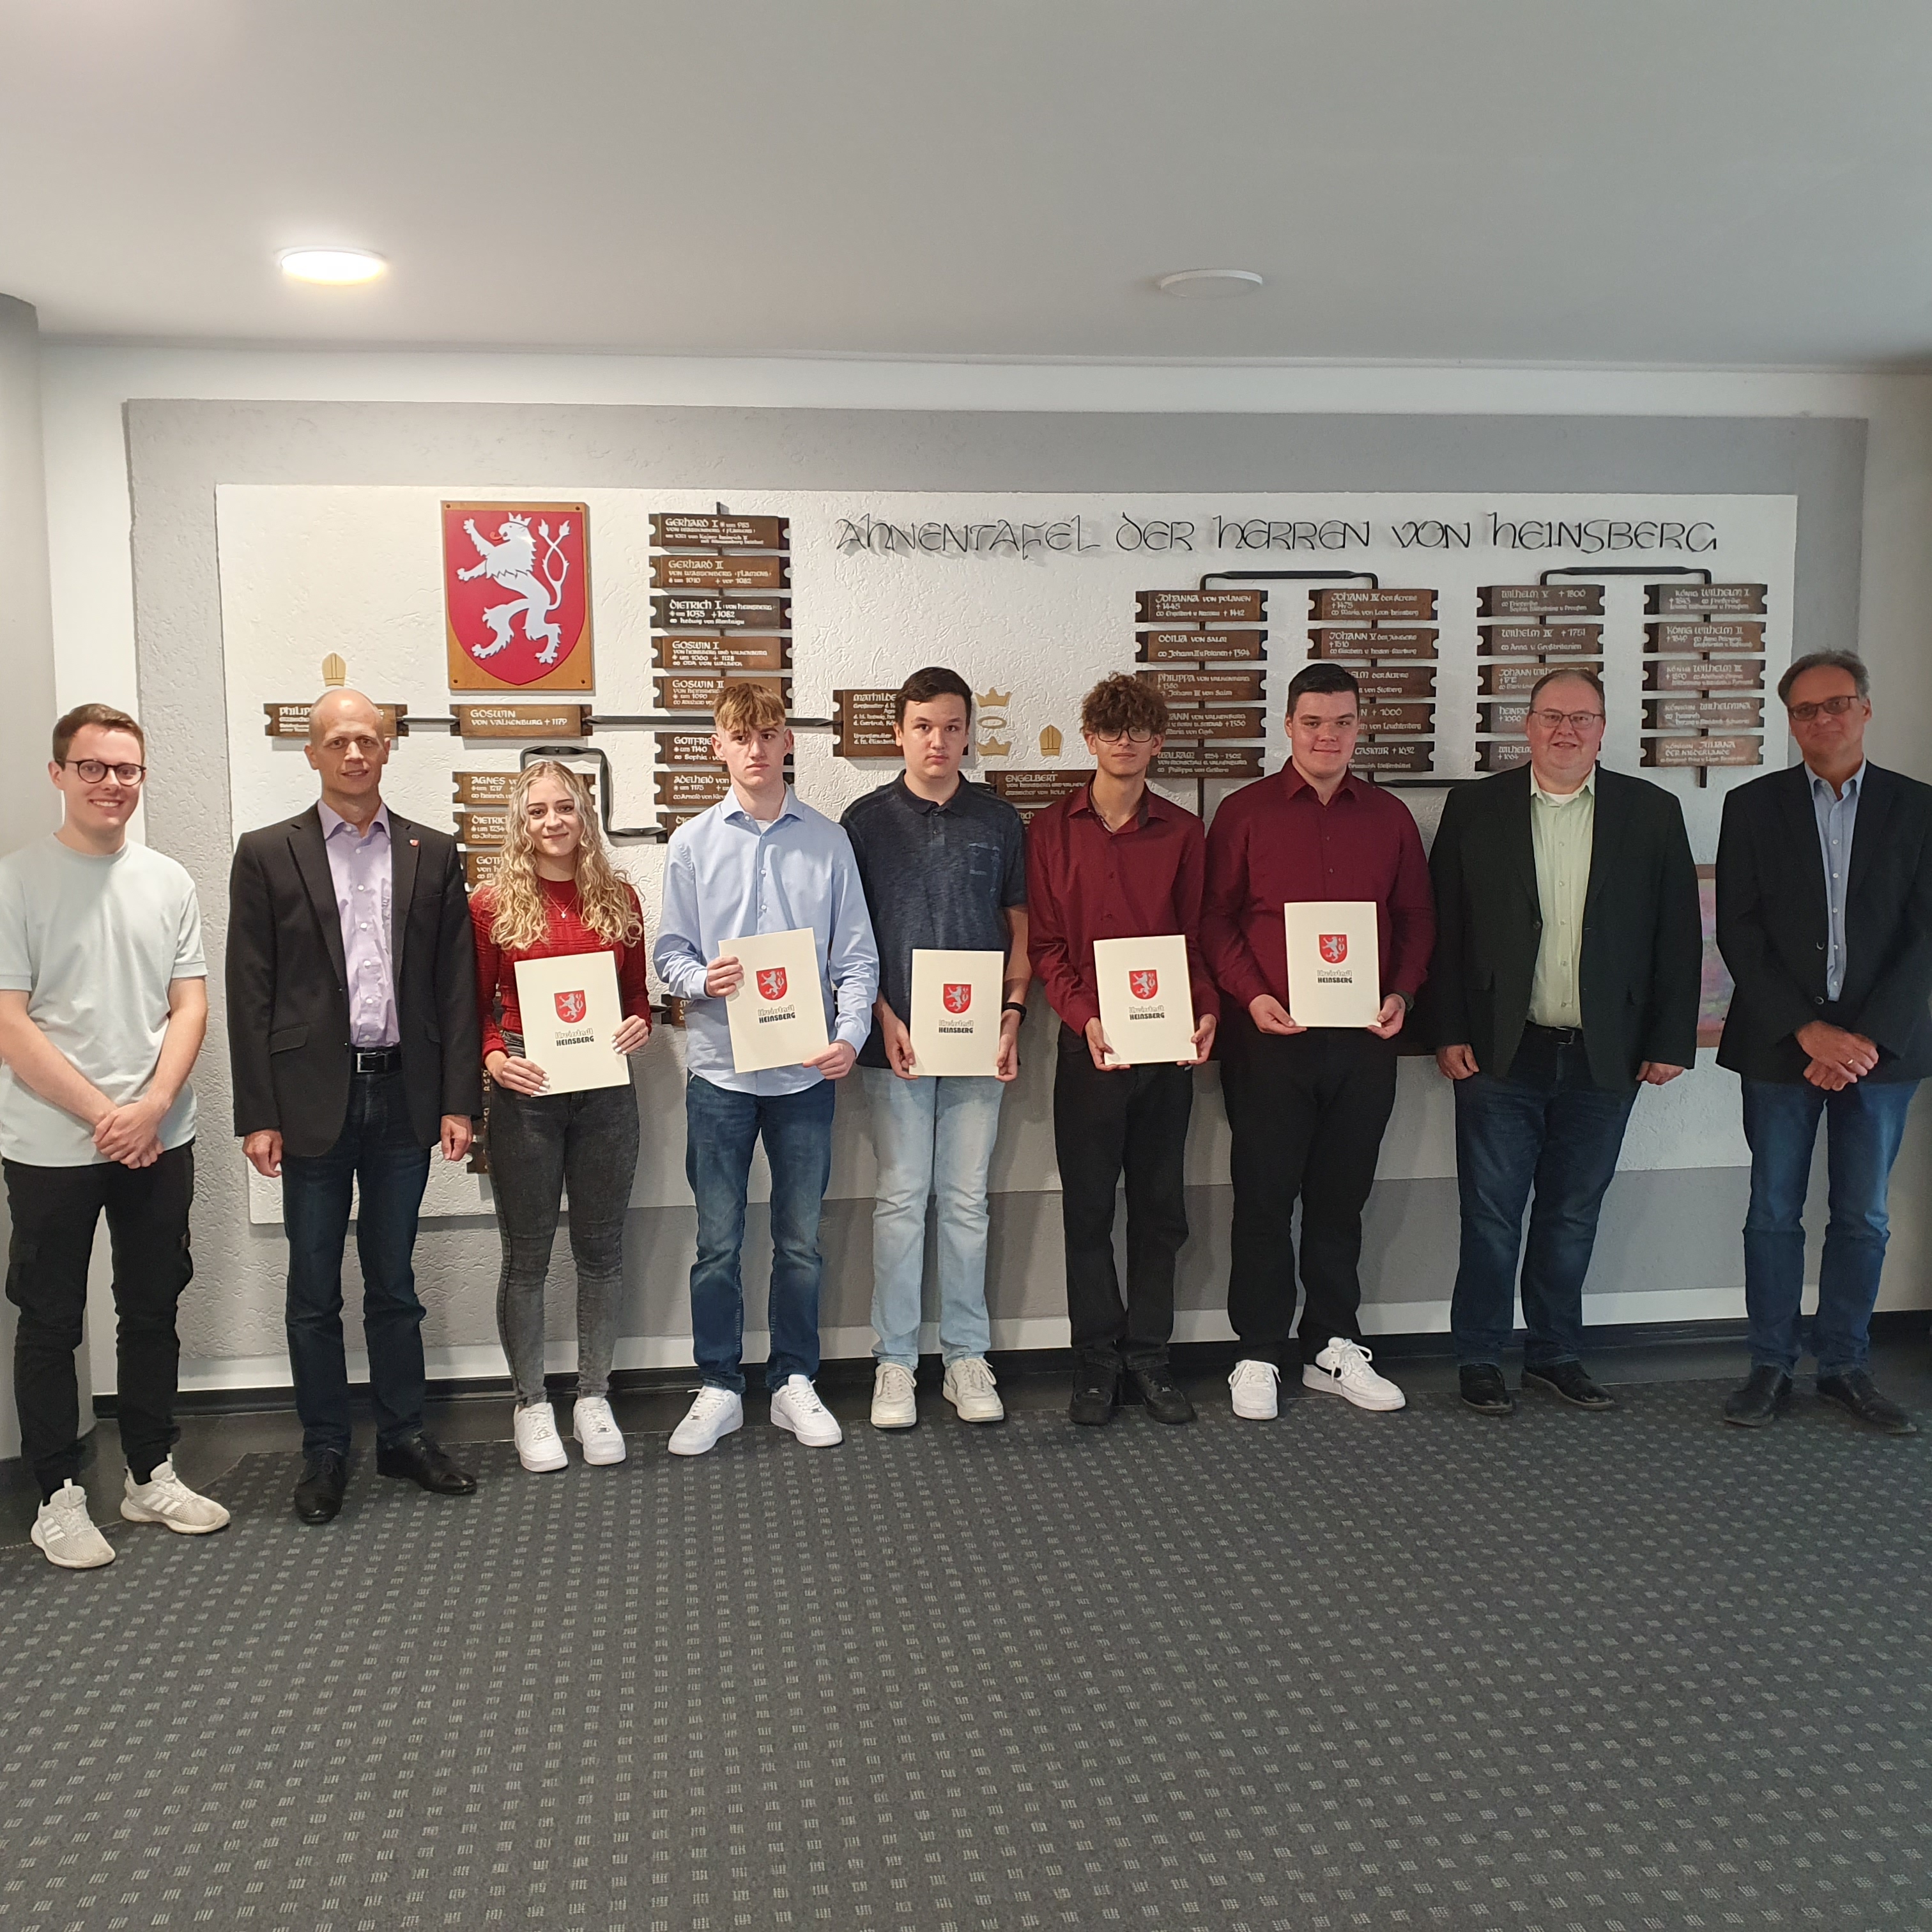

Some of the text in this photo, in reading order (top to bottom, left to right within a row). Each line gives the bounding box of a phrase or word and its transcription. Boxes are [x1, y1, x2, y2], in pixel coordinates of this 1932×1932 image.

[665, 518, 709, 527] GERHARD
[836, 512, 1717, 560] AHNENTAFEL DER HERREN VON HEINSBERG
[668, 560, 723, 569] GERHARD II
[1331, 592, 1368, 601] JOHANN
[1501, 590, 1538, 598] WILHELM
[670, 599, 712, 610] DIETRICH
[1329, 631, 1367, 640] JOHANN
[1501, 629, 1540, 637] WILHELM
[672, 641, 710, 649] GOSWIN
[672, 680, 714, 688] GOSWIN
[853, 693, 896, 702] MATHILDE
[1499, 706, 1529, 714] HEINRIC
[674, 737, 712, 745] GOTTFRIE
[673, 775, 714, 784] ADELHEID
[1005, 774, 1058, 783] ENGELBERT
[759, 1012, 795, 1023] HEINSBERG
[1130, 1012, 1165, 1020] HEINSBERG
[556, 1036, 594, 1046] HEINSBERG
